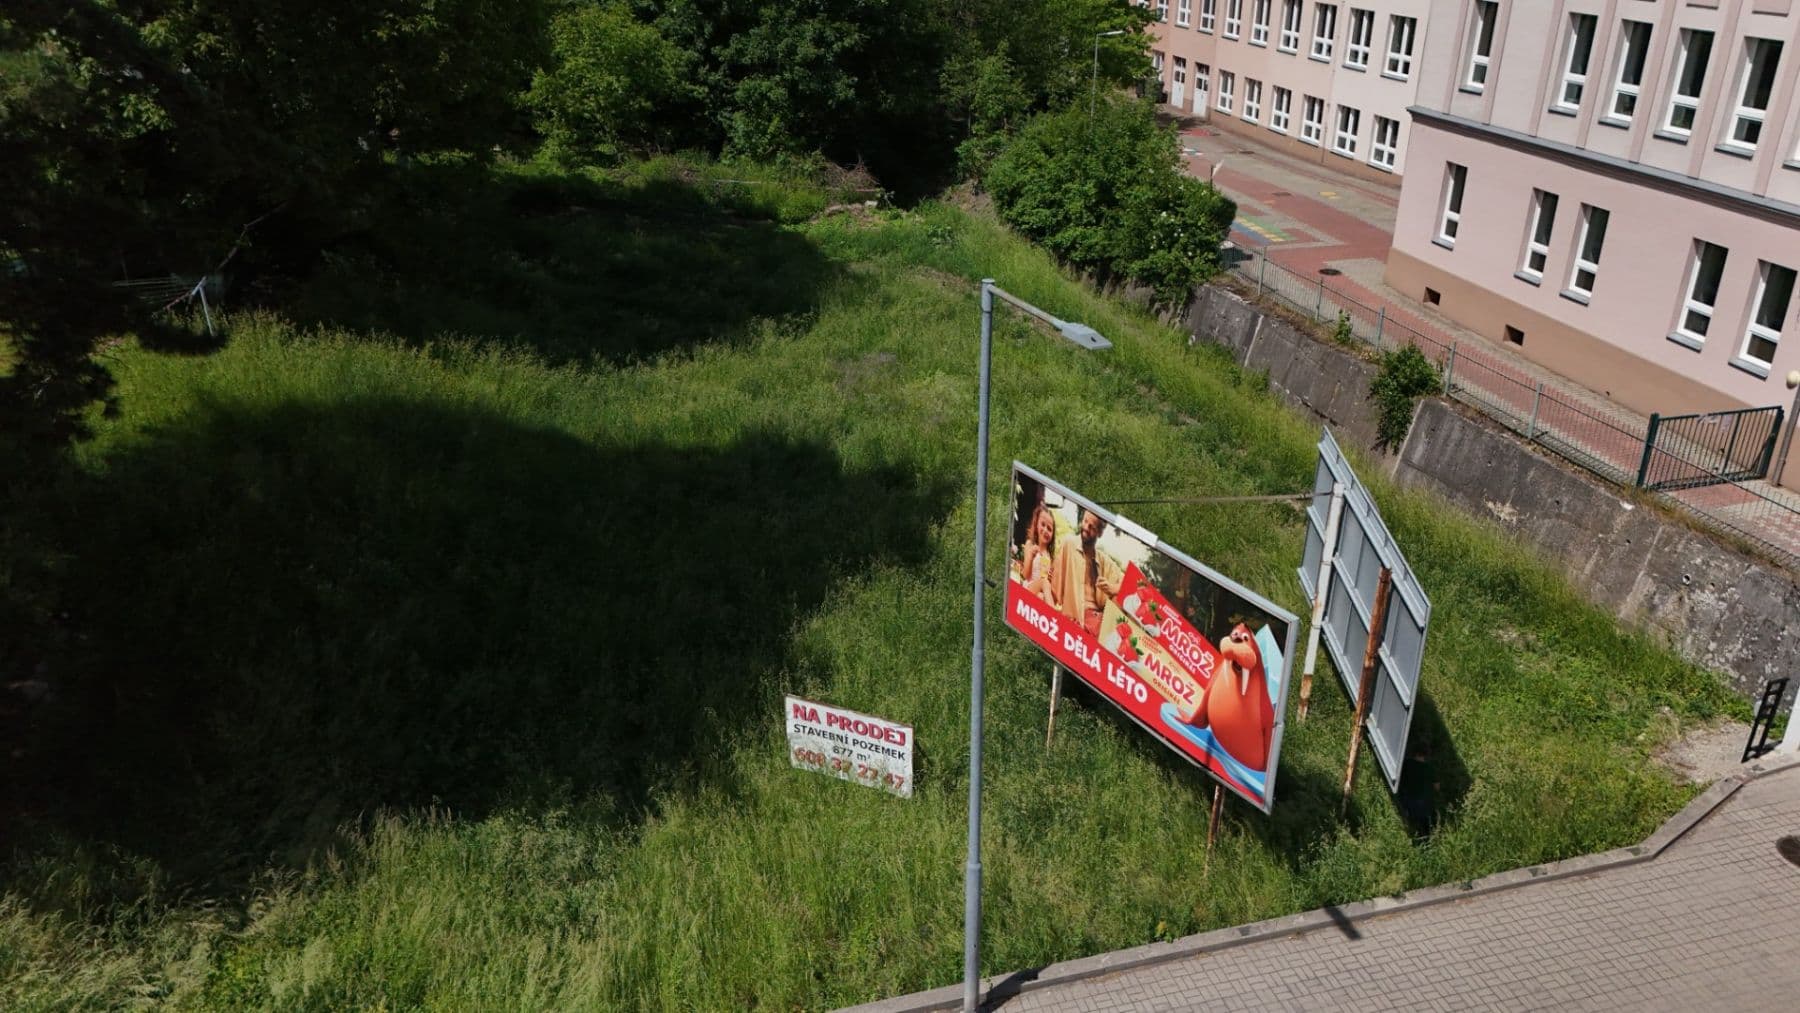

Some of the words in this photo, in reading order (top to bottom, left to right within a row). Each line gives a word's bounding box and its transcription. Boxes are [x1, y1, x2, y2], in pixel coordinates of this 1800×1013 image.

[1016, 599, 1059, 642] MROŽ
[1064, 632, 1101, 673] DĚLÁ
[1107, 662, 1148, 703] LÉTO
[1161, 618, 1214, 679] MROŽ
[1144, 653, 1196, 705] MROŽ
[792, 703, 821, 724] NA
[826, 711, 906, 747] PRODEJ
[793, 723, 849, 744] STAVEBNÍ
[852, 738, 906, 760] POZEMEK
[832, 745, 853, 757] 677
